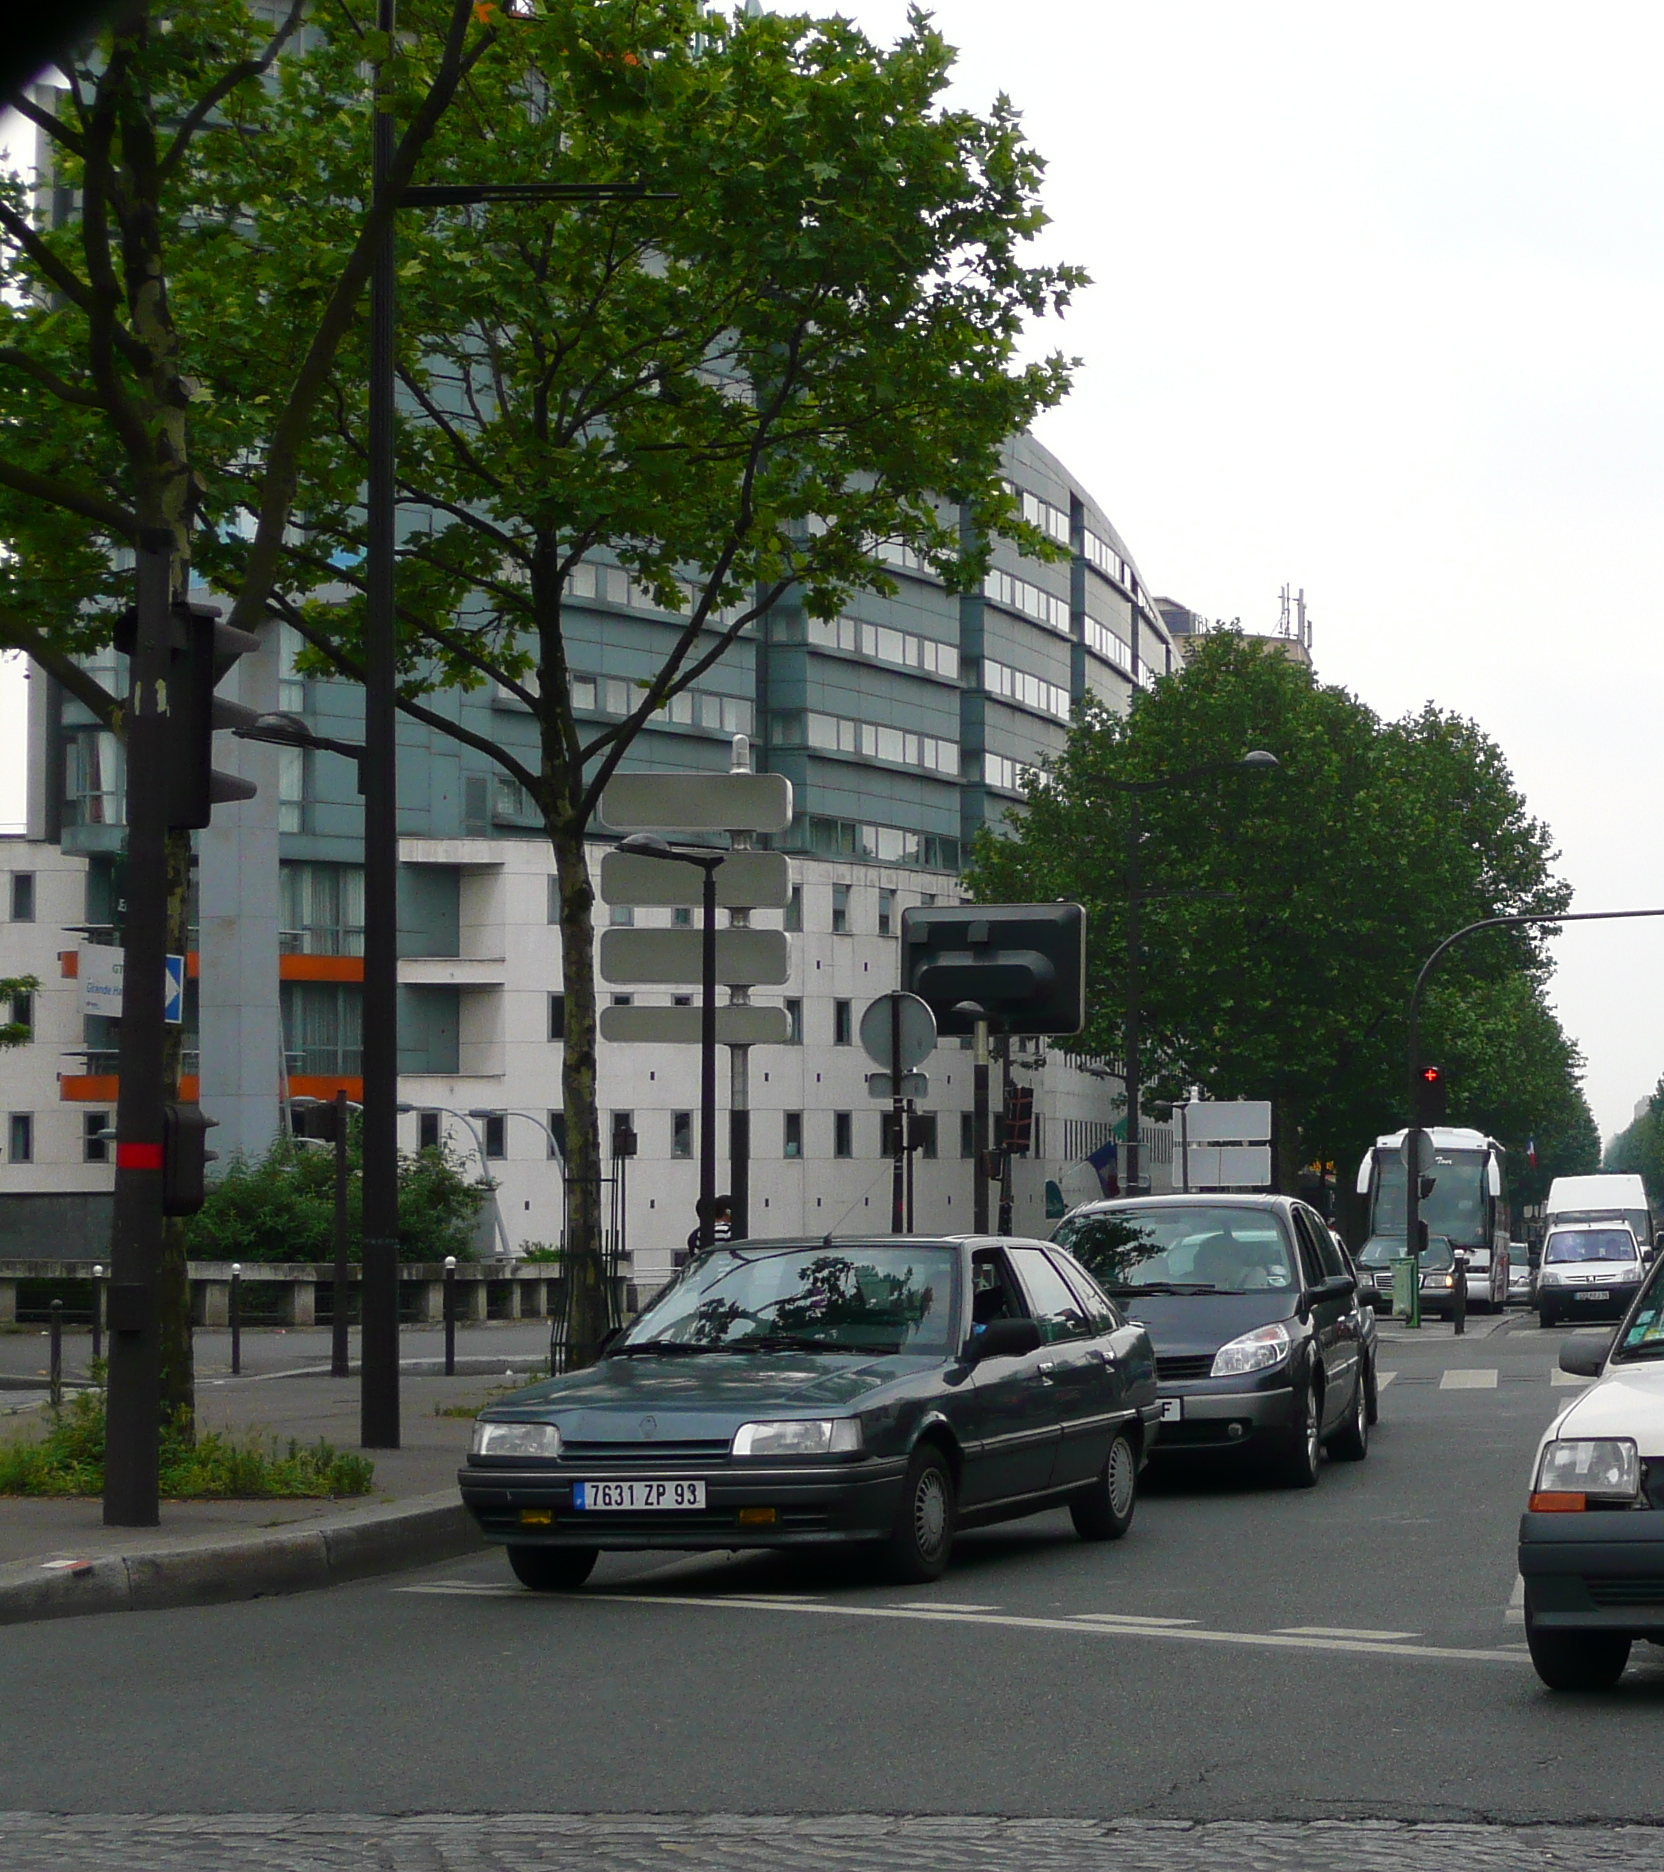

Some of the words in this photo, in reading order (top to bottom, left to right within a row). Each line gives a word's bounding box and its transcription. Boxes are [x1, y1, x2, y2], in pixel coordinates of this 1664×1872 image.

[590, 1484, 634, 1506] 7631
[644, 1484, 666, 1506] ZP
[674, 1483, 698, 1505] 93
